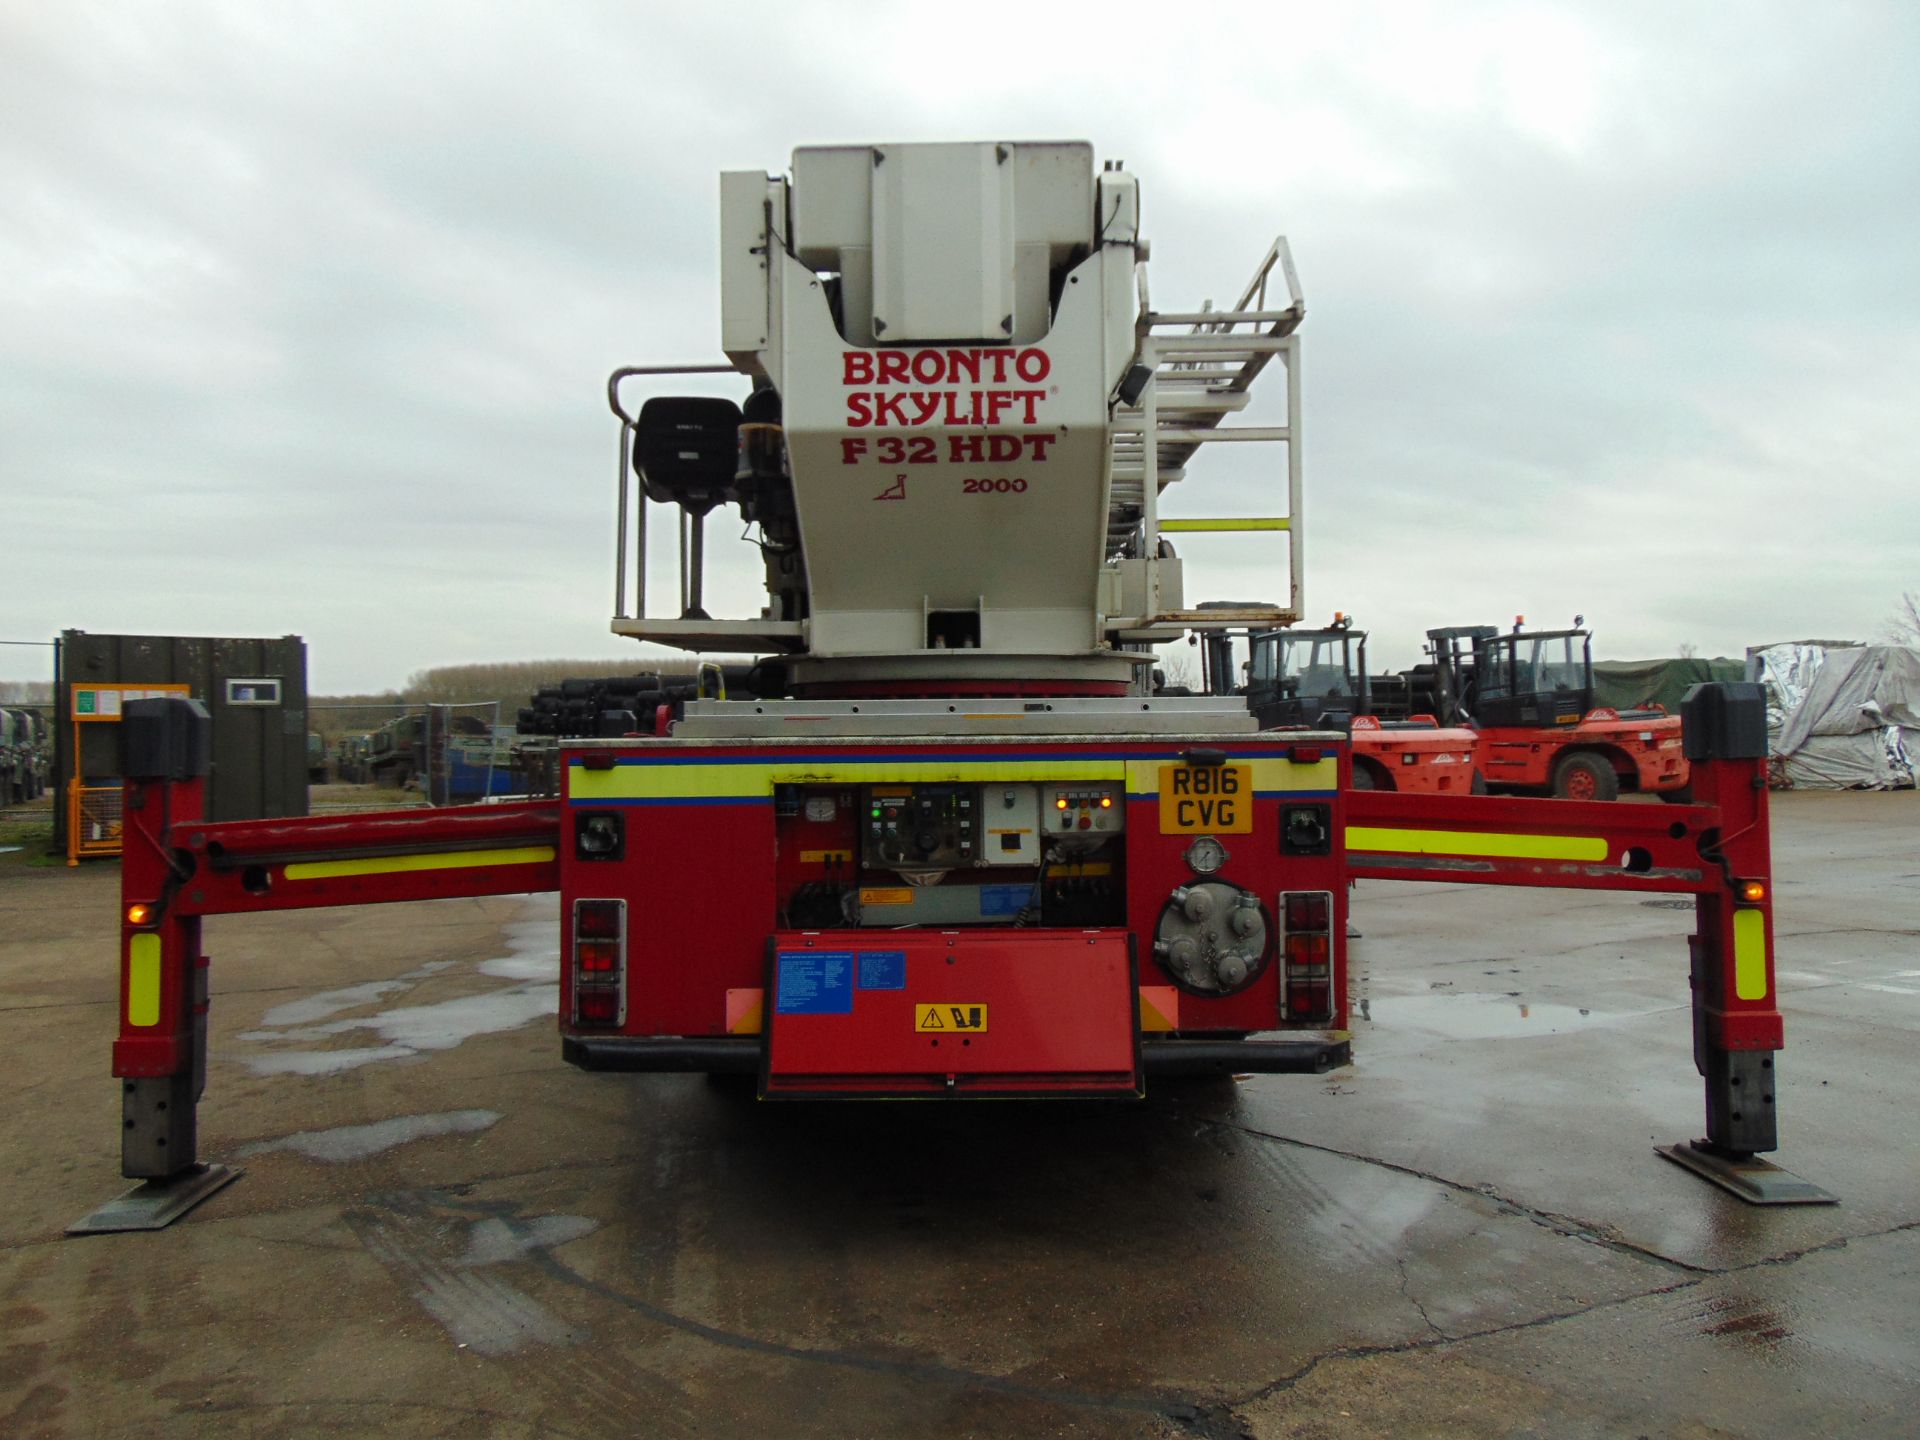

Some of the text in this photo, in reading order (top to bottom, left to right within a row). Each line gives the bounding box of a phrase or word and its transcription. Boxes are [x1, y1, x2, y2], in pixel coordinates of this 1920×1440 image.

[843, 348, 1051, 385] BRONTO
[847, 390, 1046, 427] SKYLIFT
[841, 433, 1056, 464] F 32 HDT
[962, 478, 1028, 493] 2000
[1173, 768, 1239, 795] R816
[1177, 800, 1235, 827] CVG
